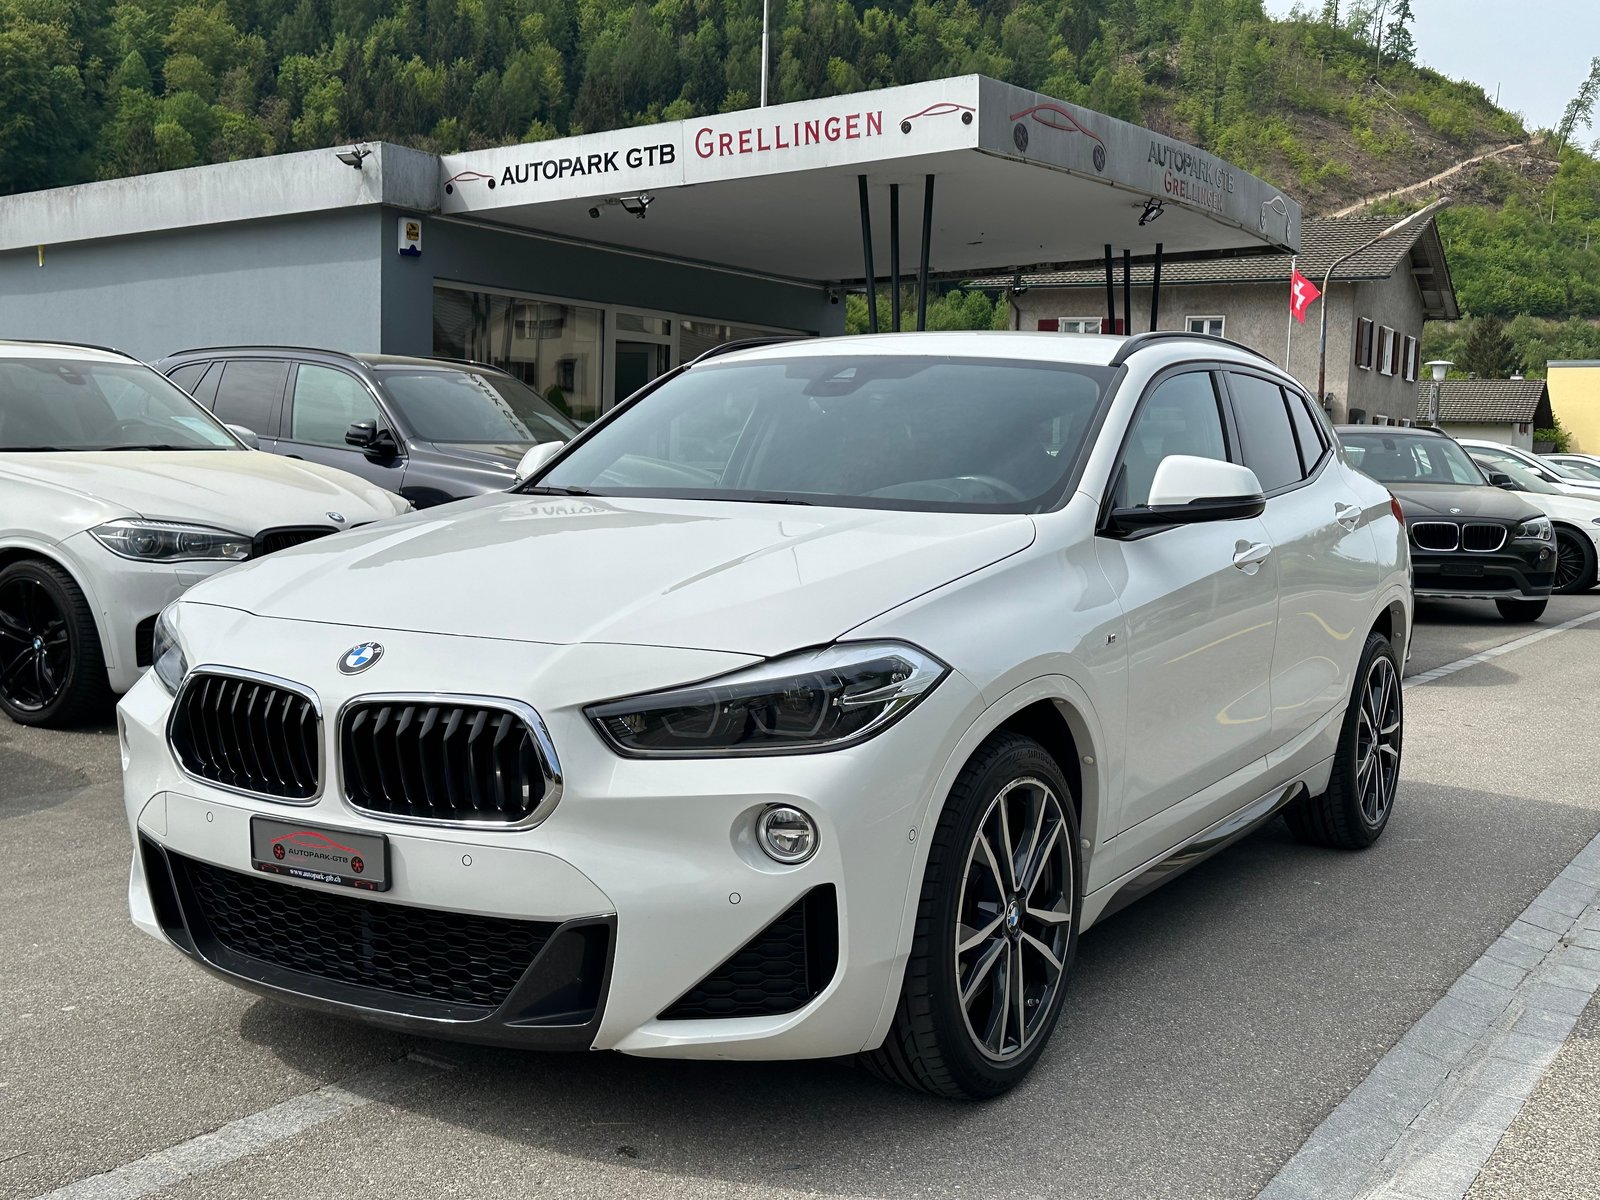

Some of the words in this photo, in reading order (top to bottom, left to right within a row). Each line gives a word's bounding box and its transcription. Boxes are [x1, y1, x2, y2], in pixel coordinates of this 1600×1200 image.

[695, 110, 883, 160] GRELLINGEN
[500, 150, 619, 186] AUTOPARK
[626, 143, 676, 169] GTB
[1147, 141, 1213, 185] AUTOPARK
[1214, 167, 1235, 194] GTB
[288, 848, 348, 863] AUTOPARK-GTB
[290, 869, 342, 883] www.autopark-gtb.ch
